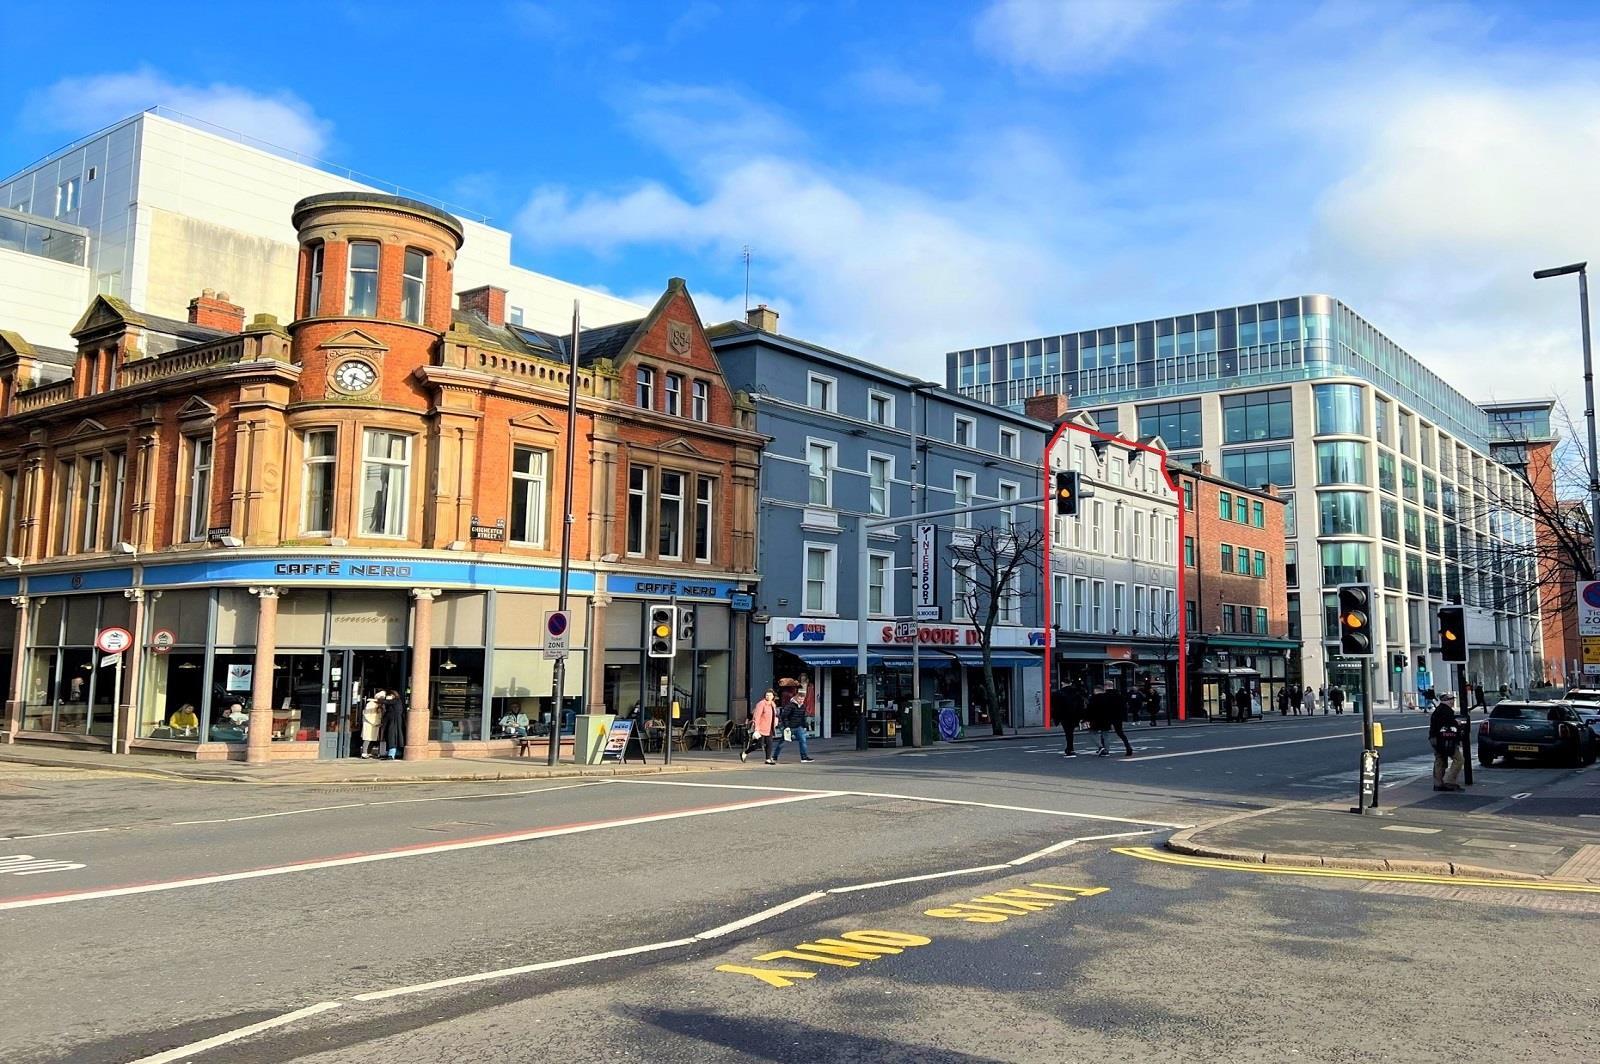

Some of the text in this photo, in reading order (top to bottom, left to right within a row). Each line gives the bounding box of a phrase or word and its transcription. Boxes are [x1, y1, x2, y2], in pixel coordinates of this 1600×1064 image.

[349, 564, 412, 577] NERO
[922, 534, 930, 604] INTERSPORT
[683, 585, 717, 596] NERO
[334, 616, 379, 624] ESPRESSO
[803, 623, 826, 633] INTER
[714, 929, 932, 988] ONLY
